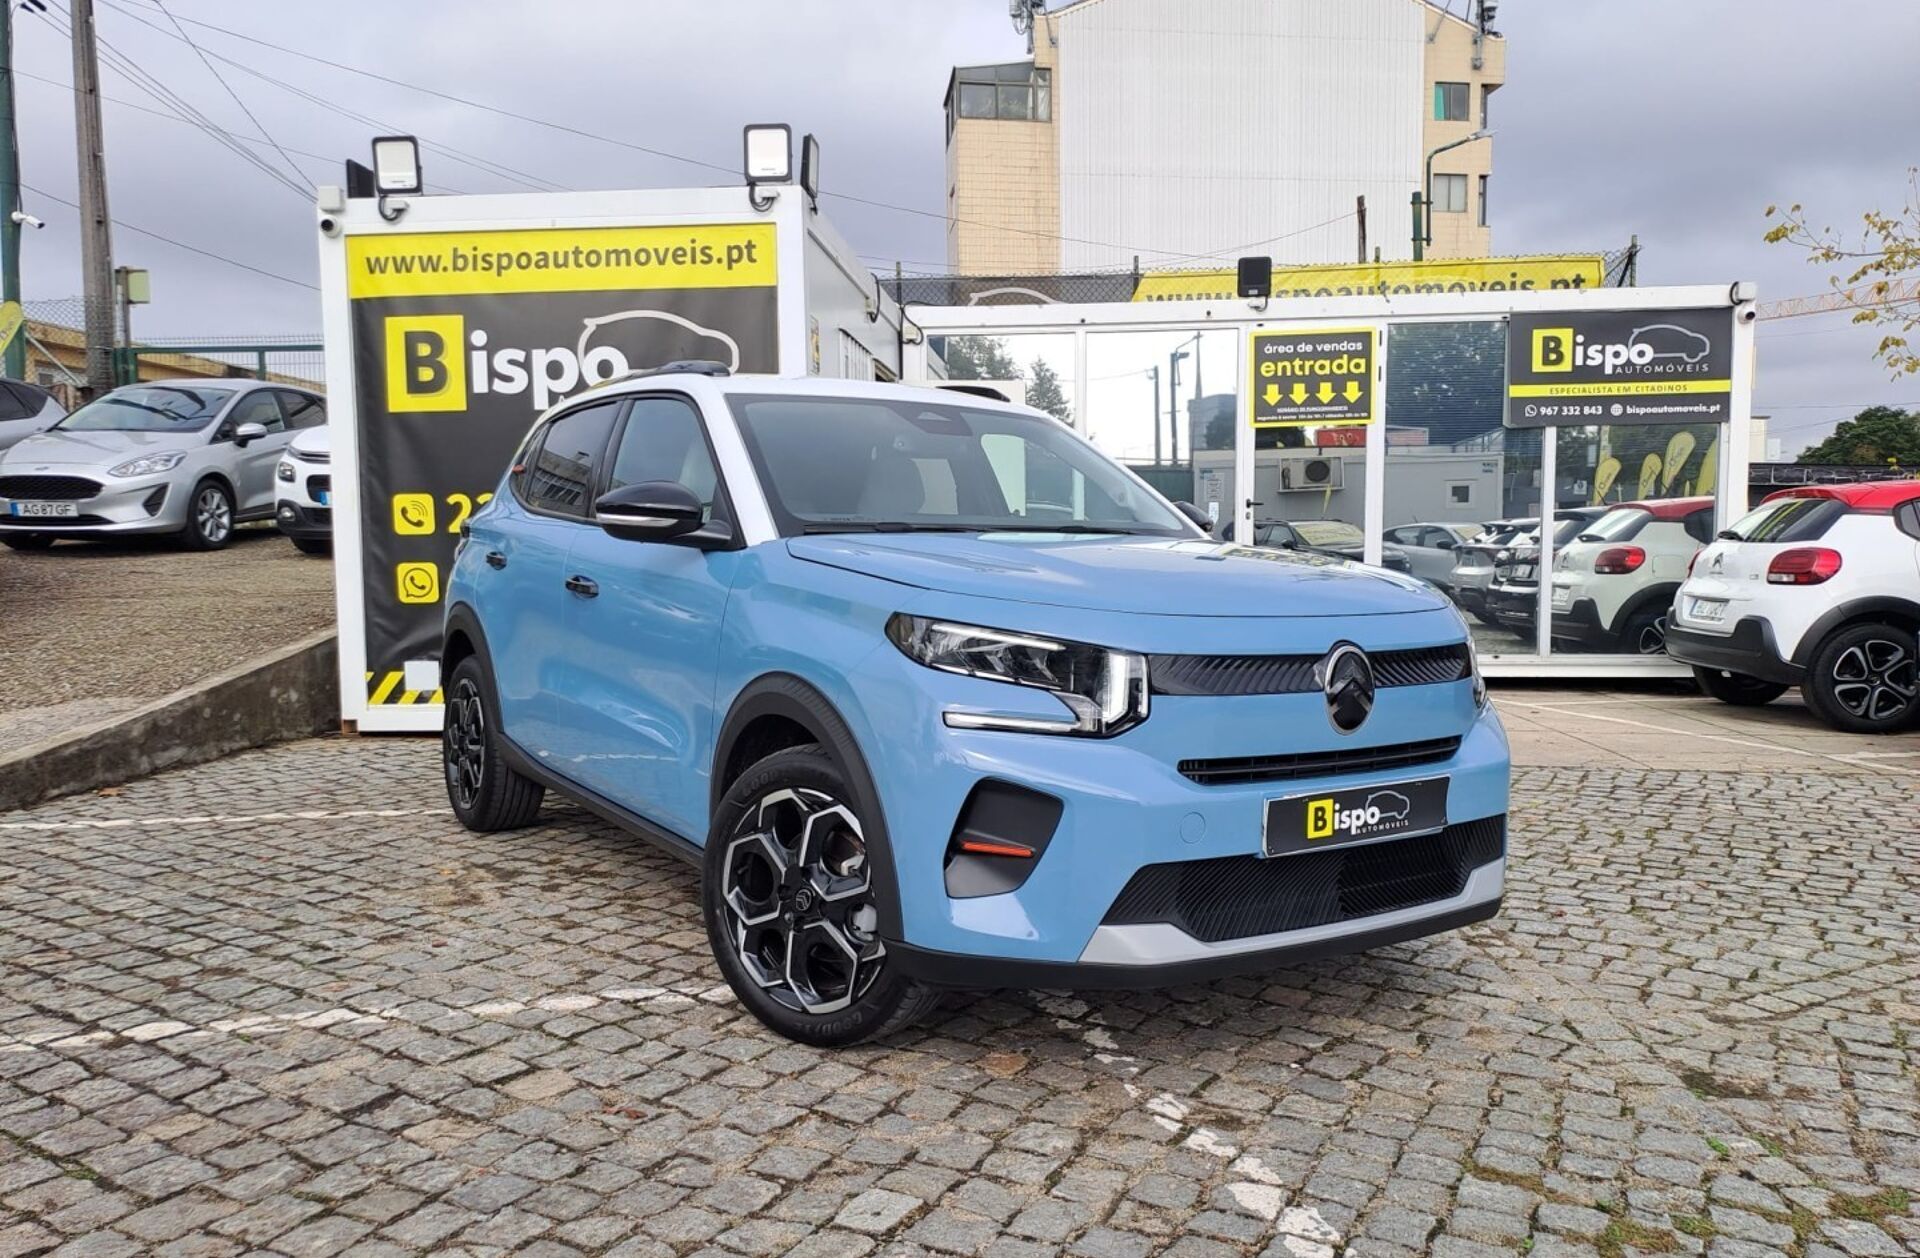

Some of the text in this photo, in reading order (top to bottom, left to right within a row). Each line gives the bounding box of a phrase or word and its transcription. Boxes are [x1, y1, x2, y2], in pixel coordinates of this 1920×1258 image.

[366, 238, 757, 277] www.bispoautomoveis.pt
[1264, 340, 1363, 354] área de vendas
[1541, 334, 1654, 375] Bispo
[404, 329, 629, 411] Bispo
[1260, 354, 1367, 377] entrada
[1615, 362, 1710, 375] AUTOMÓVEIS
[1549, 384, 1688, 395] ESPECIALISTA EM CITADINOS
[1539, 405, 1603, 416] 967 332 843
[1626, 403, 1721, 415] bispoautomoveis.pt
[1312, 803, 1381, 835] Bispo
[1356, 819, 1409, 834] AUTOMÓVEIS
